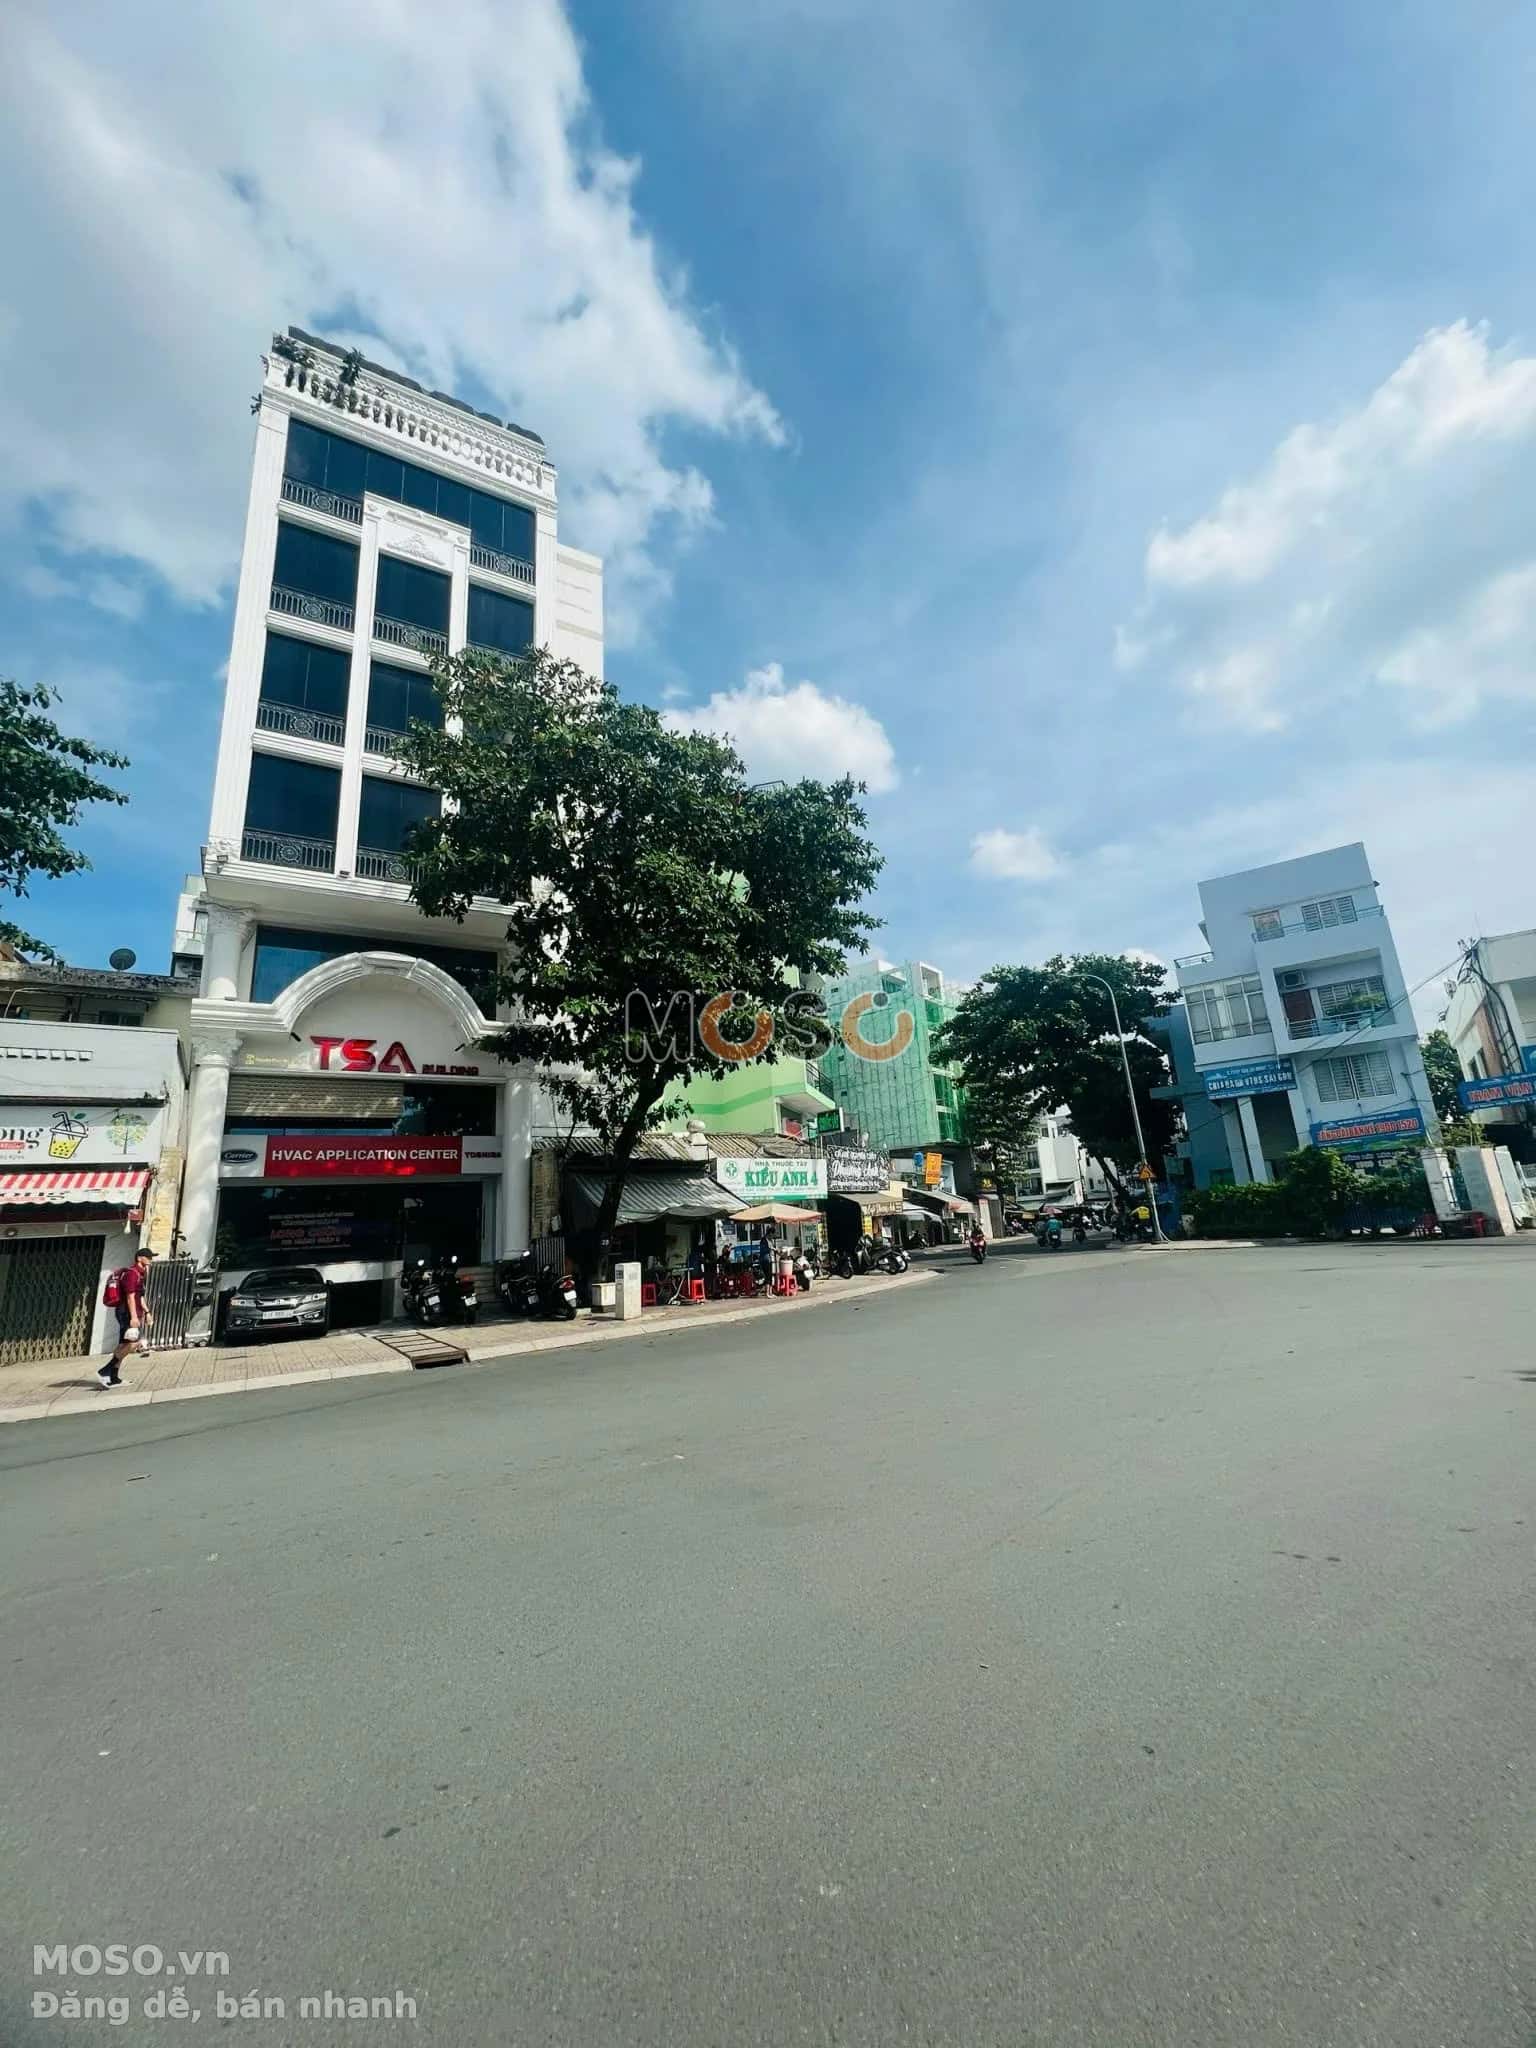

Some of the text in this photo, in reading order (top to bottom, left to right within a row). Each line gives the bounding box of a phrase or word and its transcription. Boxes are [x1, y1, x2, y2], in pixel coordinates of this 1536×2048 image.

[310, 1035, 417, 1073] TSA
[421, 1063, 479, 1076] BUILDING
[271, 1148, 459, 1161] HVAC APPLICATION CENTER
[464, 1151, 502, 1159] TOSHIBA
[780, 1170, 809, 1187] ANH
[810, 1170, 819, 1186] 4
